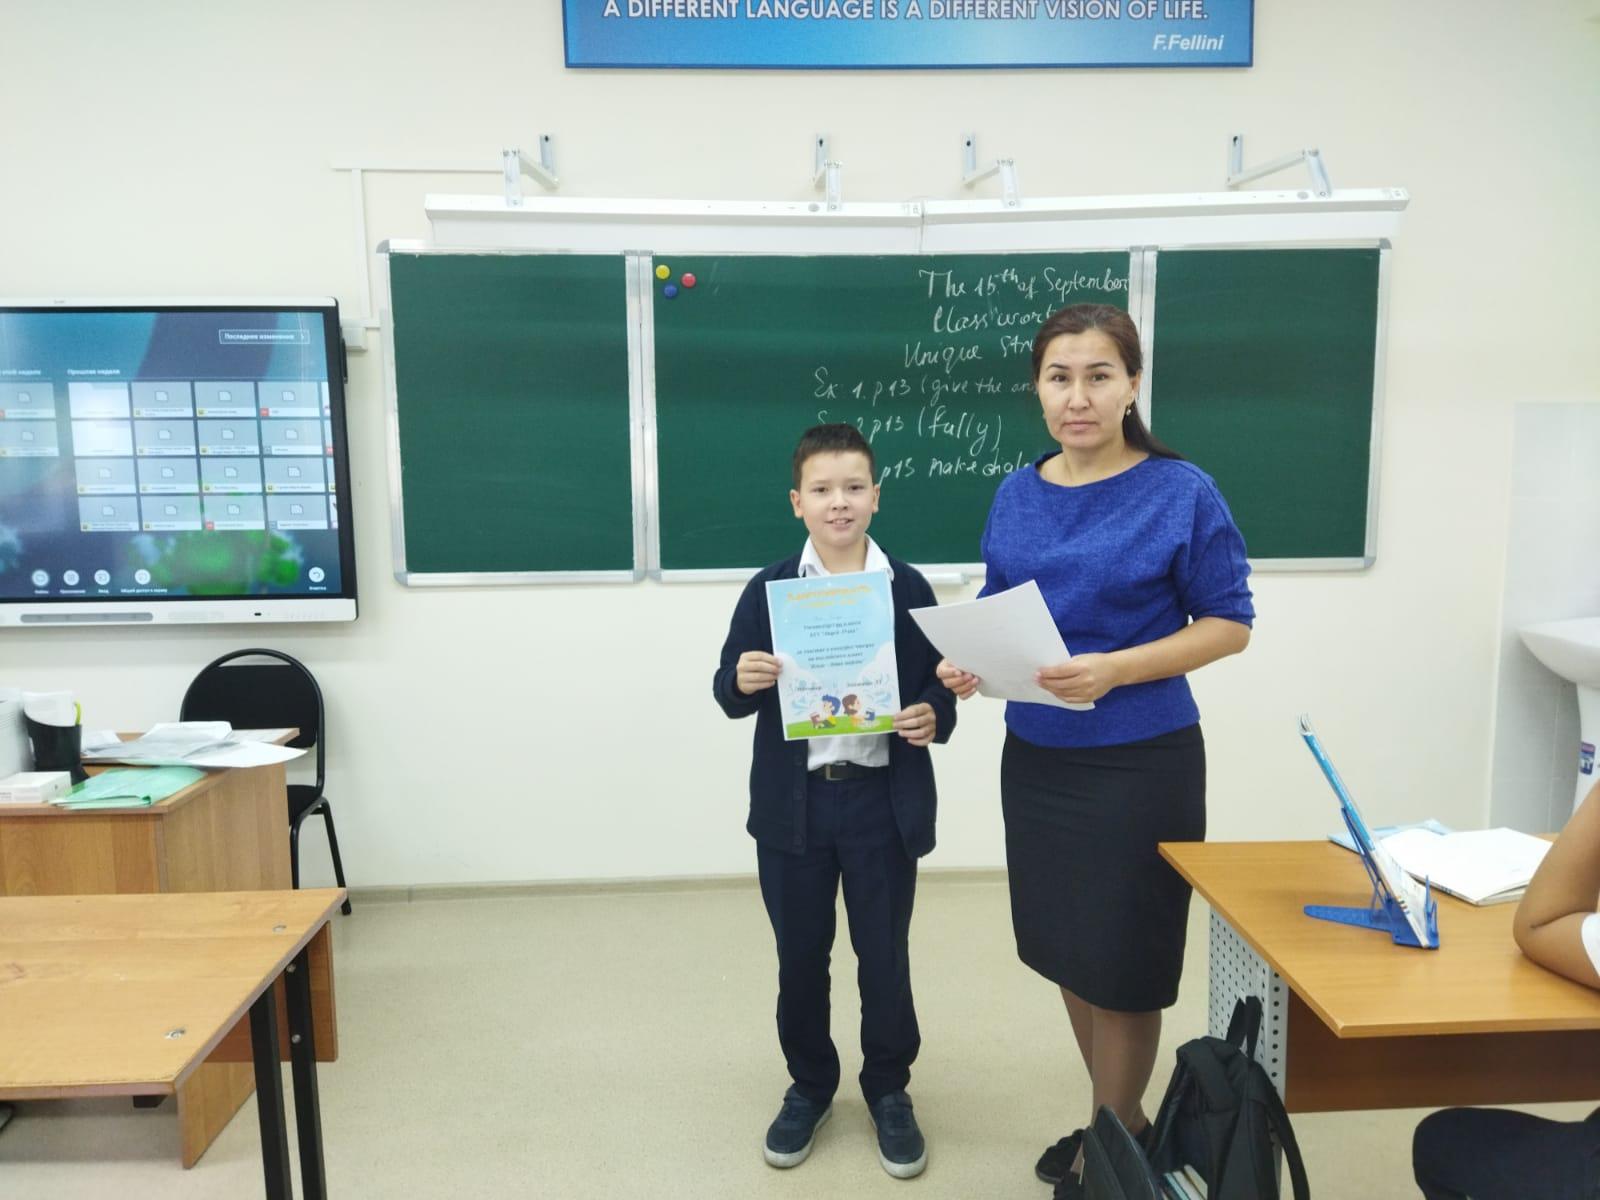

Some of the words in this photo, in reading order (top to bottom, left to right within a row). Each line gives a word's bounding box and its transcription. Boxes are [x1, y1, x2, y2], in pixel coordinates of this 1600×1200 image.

[603, 0, 621, 18] A
[628, 0, 739, 19] DIFFERENT
[746, 0, 874, 19] LANGUAGE
[880, 0, 899, 19] IS
[905, 0, 922, 18] A
[929, 0, 1038, 19] DIFFERENT
[1046, 0, 1121, 19] VISION
[1127, 0, 1158, 19] OF
[1164, 0, 1209, 19] LIFE.
[1152, 34, 1225, 51] F.Fellini
[919, 269, 967, 298] The
[904, 341, 983, 375] Unique
[974, 376, 1002, 393] the
